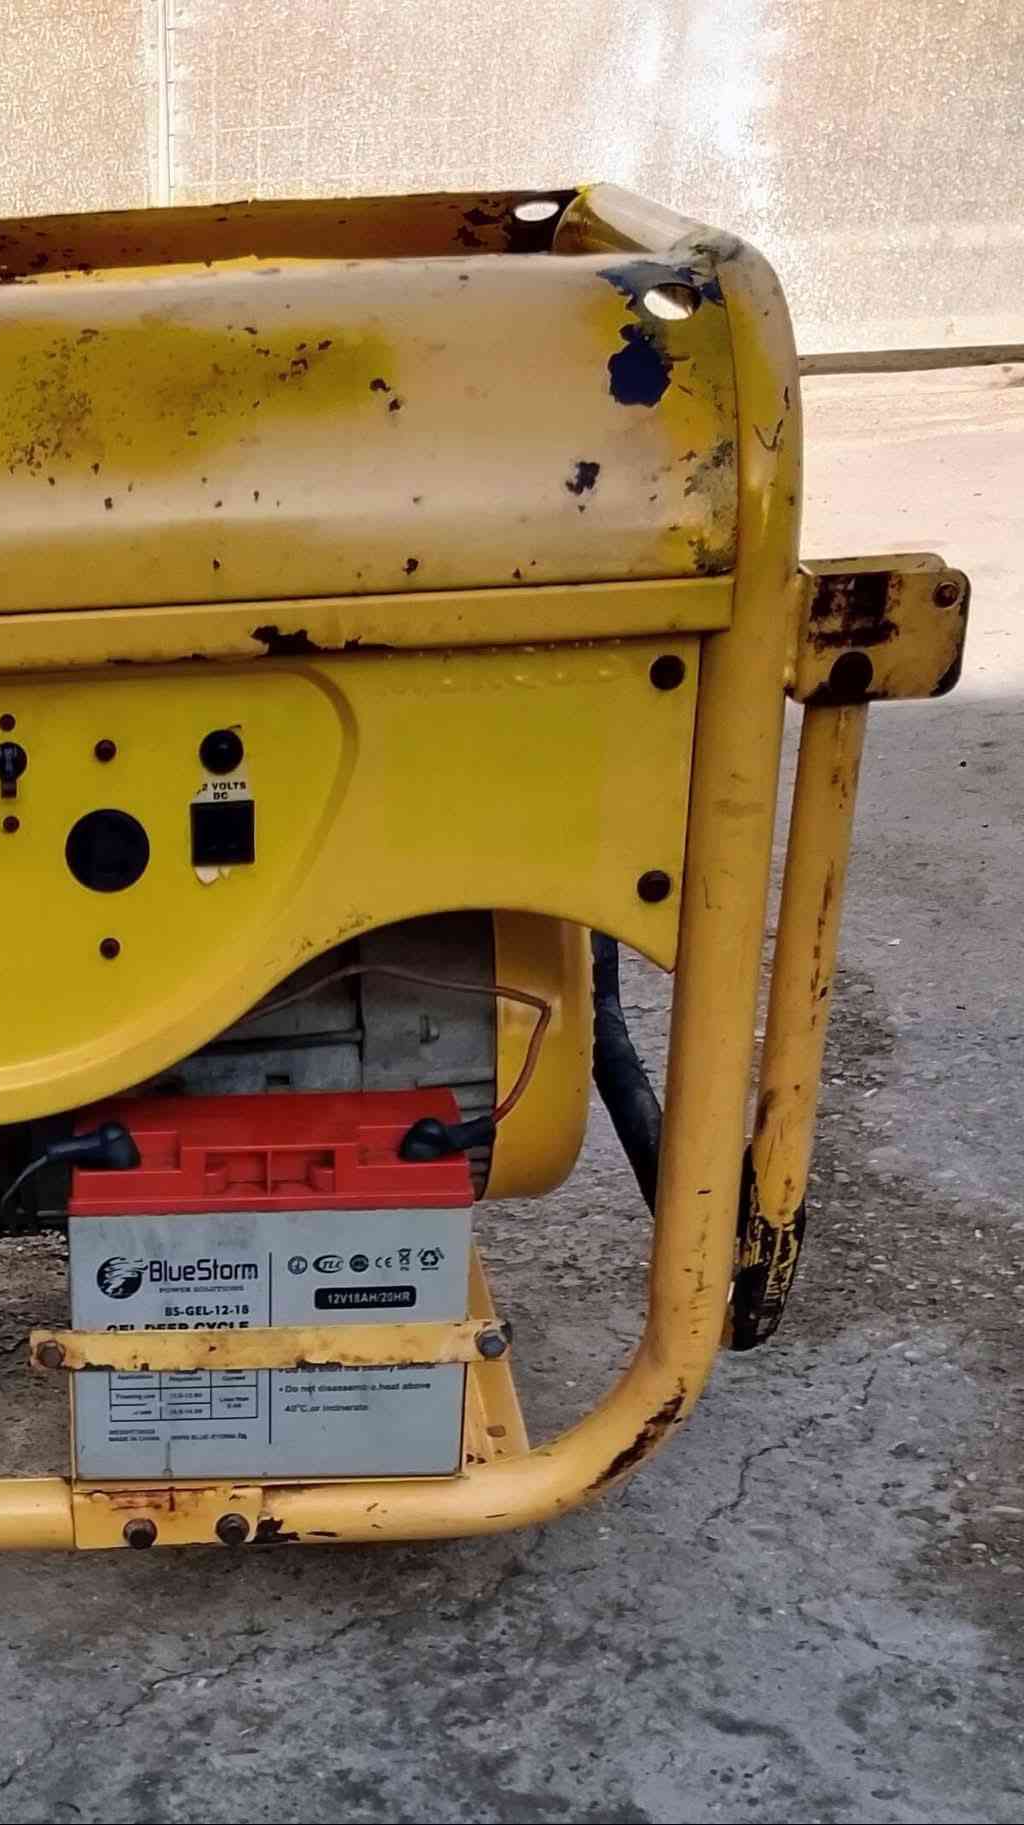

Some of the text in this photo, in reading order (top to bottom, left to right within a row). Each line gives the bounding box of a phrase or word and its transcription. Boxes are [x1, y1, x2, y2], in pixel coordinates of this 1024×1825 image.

[211, 782, 246, 791] VOLTS
[213, 792, 229, 800] DC
[149, 1259, 258, 1282] BlueStorm
[165, 1304, 250, 1317] BS-GEL-12-18
